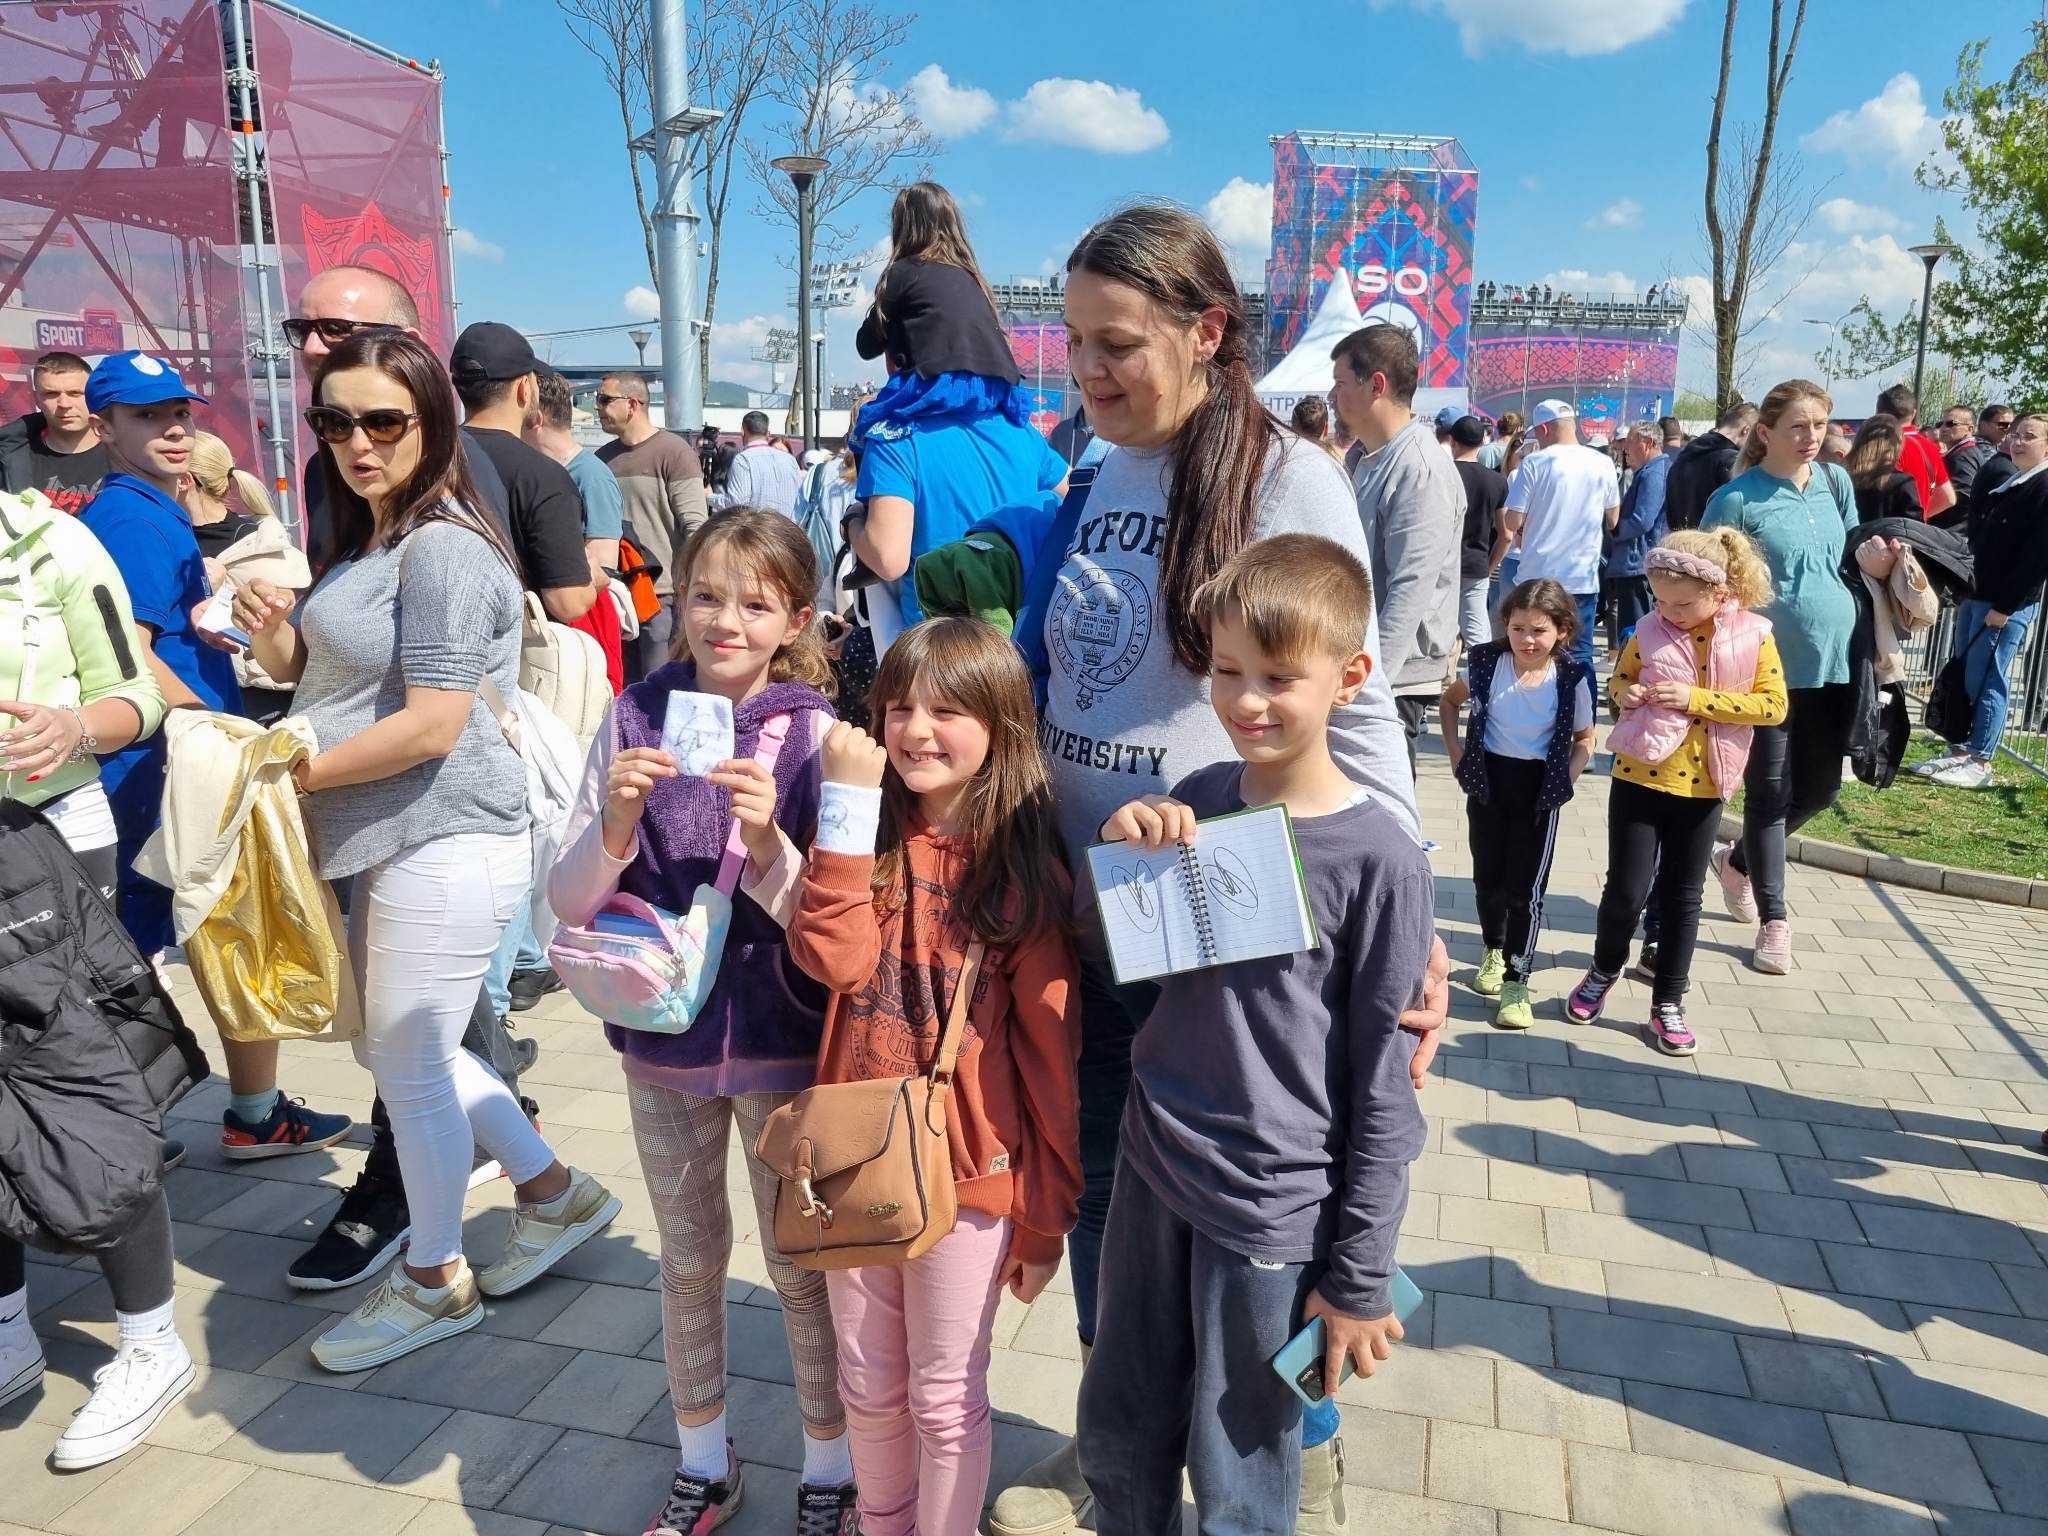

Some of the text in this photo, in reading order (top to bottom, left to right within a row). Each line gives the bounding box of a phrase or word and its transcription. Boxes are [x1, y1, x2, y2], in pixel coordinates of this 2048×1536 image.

[1357, 265, 1428, 296] SO
[40, 322, 84, 347] SPORT
[1068, 511, 1166, 558] XFOR
[1121, 578, 1138, 592] OF
[1113, 604, 1147, 676] OXFORD
[867, 1046, 890, 1069] BUILT
[889, 1060, 906, 1074] FOR
